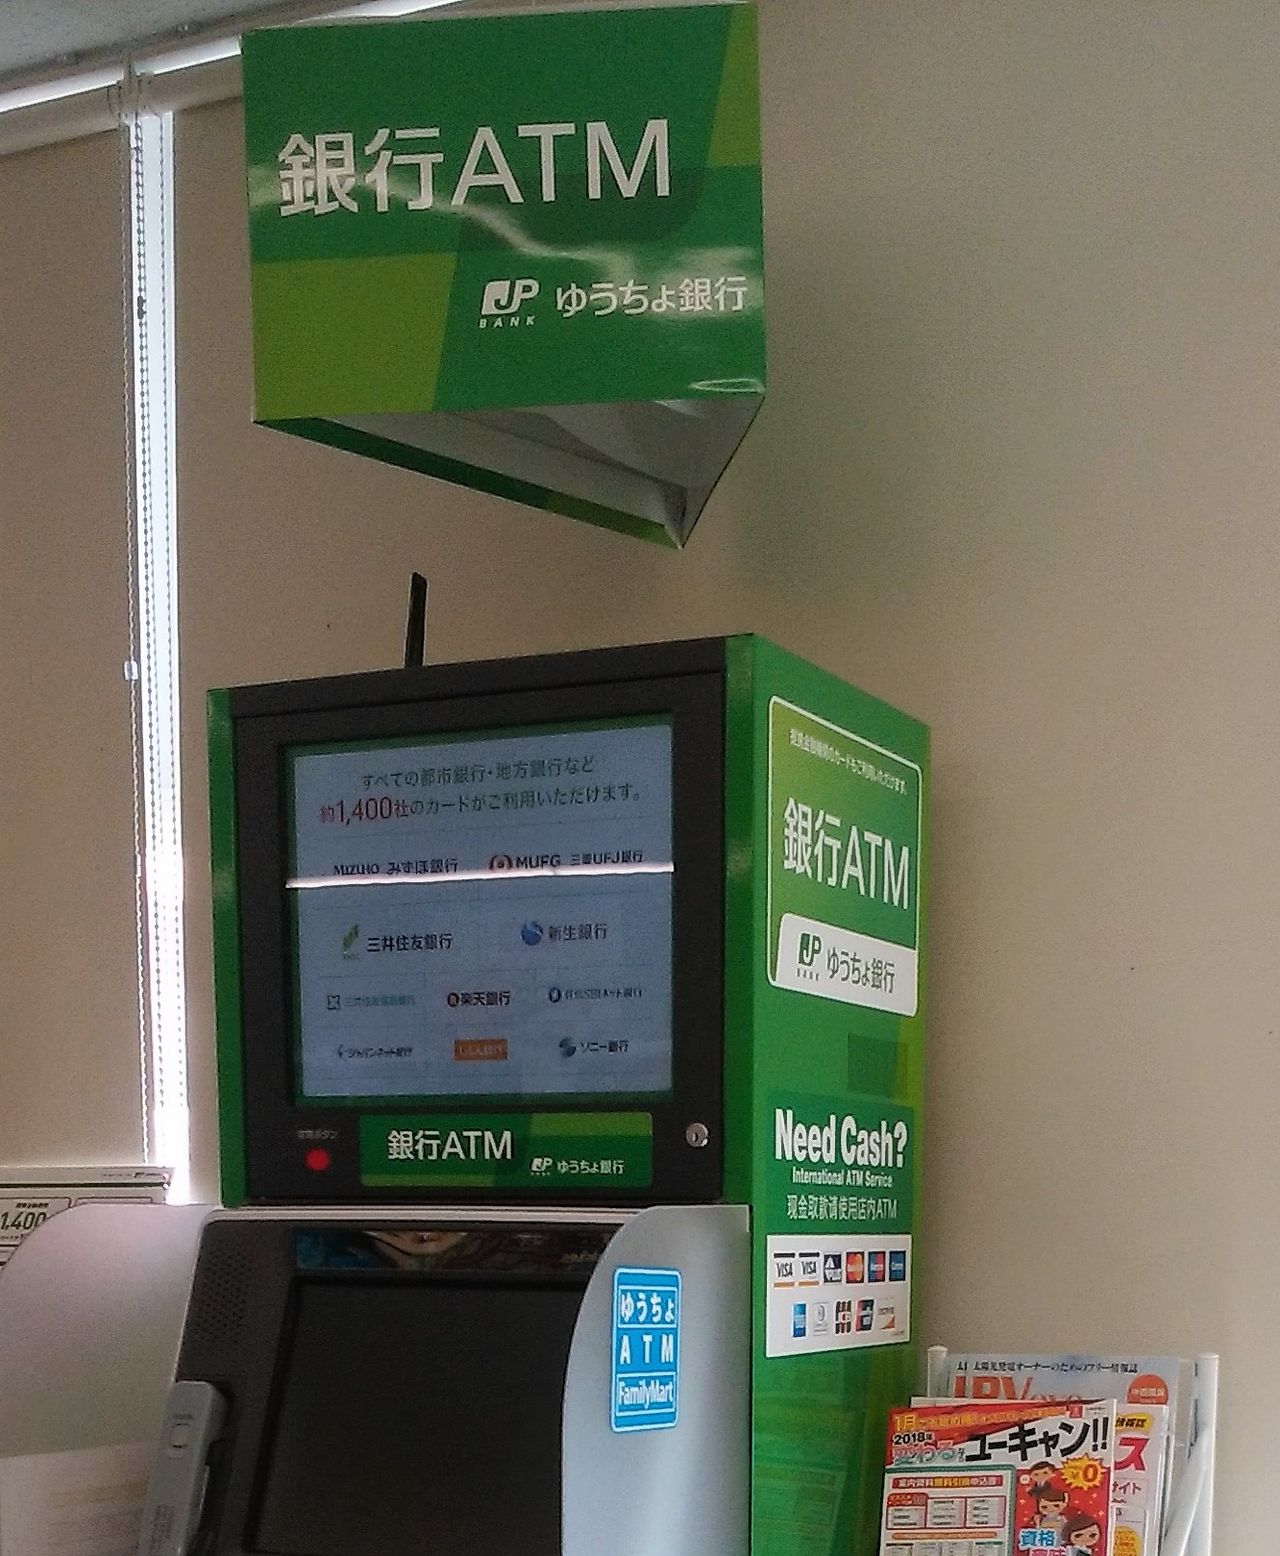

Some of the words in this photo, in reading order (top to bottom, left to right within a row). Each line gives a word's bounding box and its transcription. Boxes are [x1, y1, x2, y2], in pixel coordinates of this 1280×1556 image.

[279, 118, 671, 217] 銀行ATM
[555, 275, 748, 318] ゆうちょ銀行
[478, 315, 536, 329] BANK
[783, 797, 910, 910] 銀行ATM
[367, 933, 453, 953] 三井住友銀行
[826, 946, 896, 995] ゆうちょ銀行
[387, 1128, 513, 1162] 銀行ATM
[775, 1107, 837, 1164] Need
[840, 1115, 908, 1168] Cash?
[557, 1159, 625, 1175] ゆうちょ銀行
[792, 1166, 844, 1188] International
[846, 1169, 863, 1188] ATM
[864, 1171, 893, 1189] Service
[620, 1291, 675, 1324] ゆうちょ
[618, 1378, 674, 1410] FamilyMart
[1020, 1530, 1056, 1547] 資格
